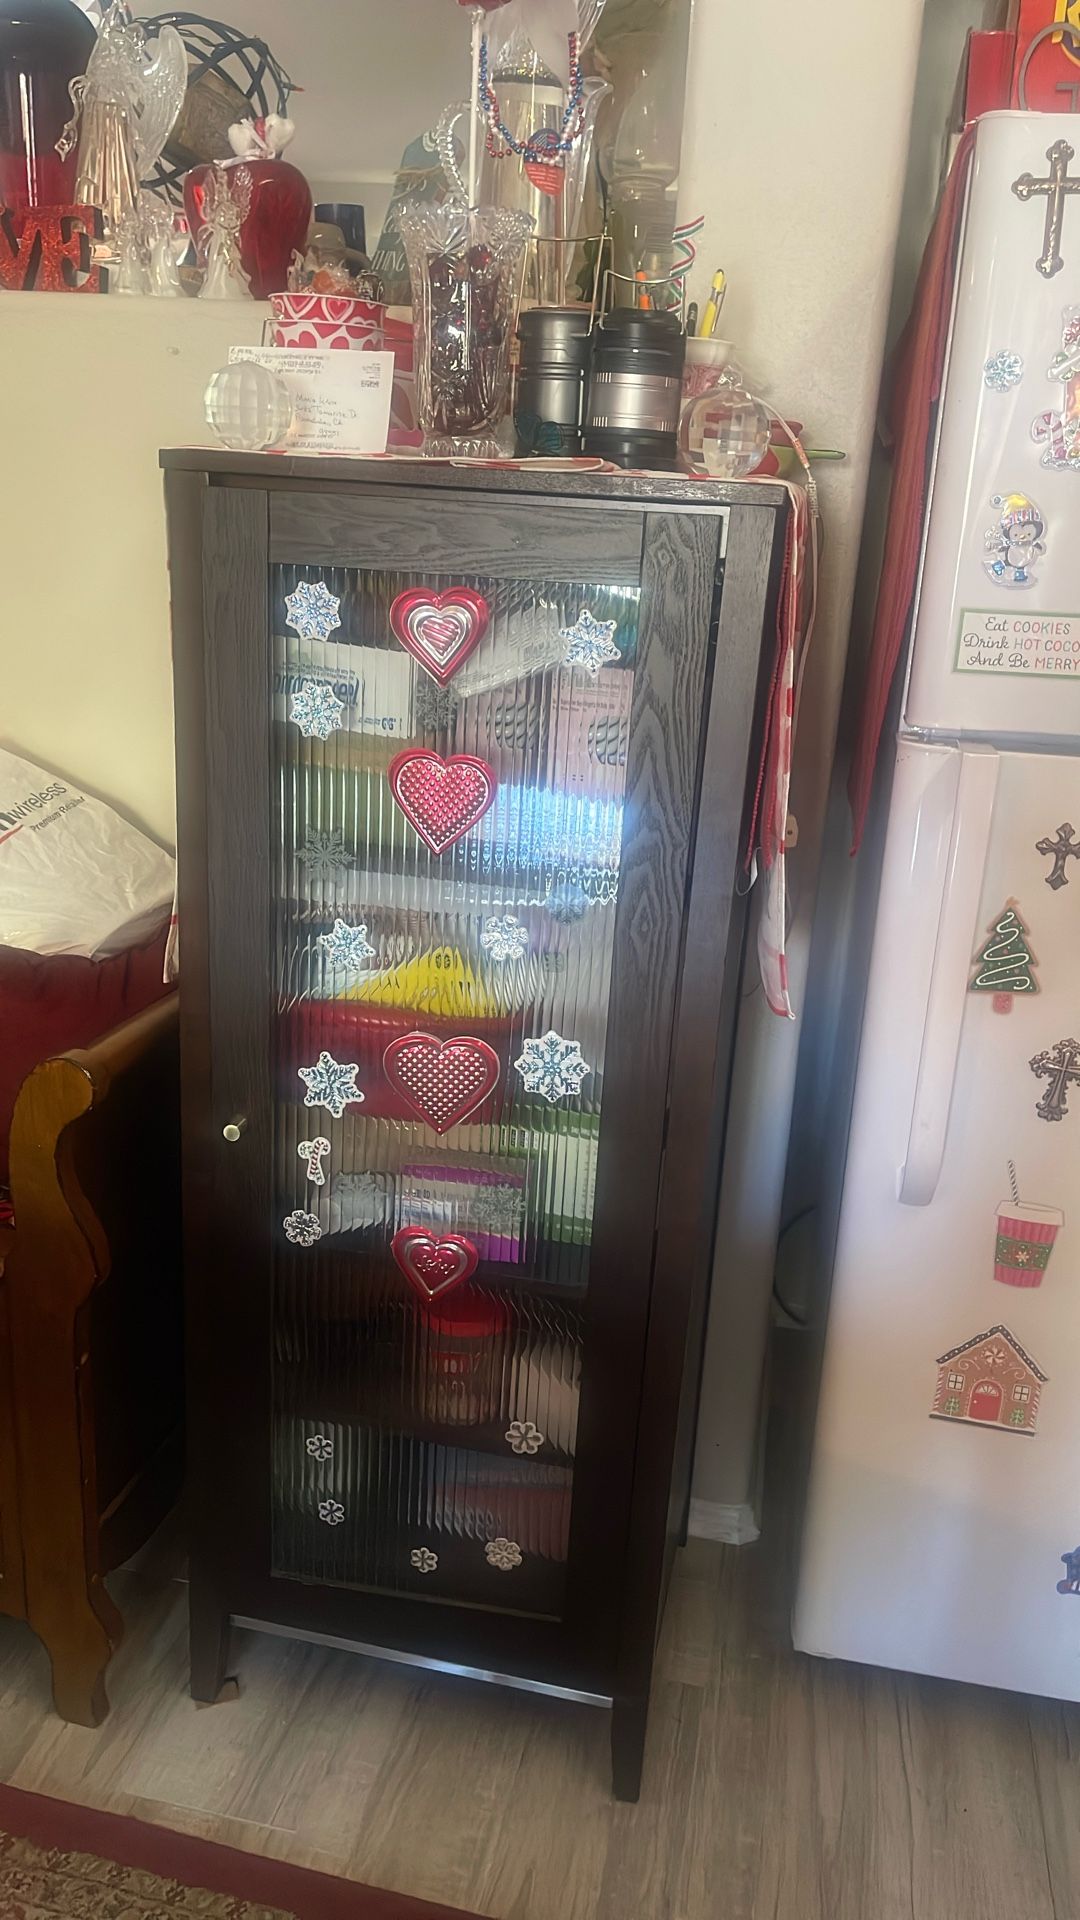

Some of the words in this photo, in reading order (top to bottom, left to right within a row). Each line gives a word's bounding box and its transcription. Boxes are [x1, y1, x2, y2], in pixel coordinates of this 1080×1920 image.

[985, 616, 1009, 632] Eat
[1013, 620, 1071, 635] COOKIES
[963, 632, 1010, 649] Drink
[1014, 638, 1041, 650] HOT
[966, 651, 1004, 667] And
[1008, 652, 1030, 668] Be
[1034, 657, 1080, 671] MERRY
